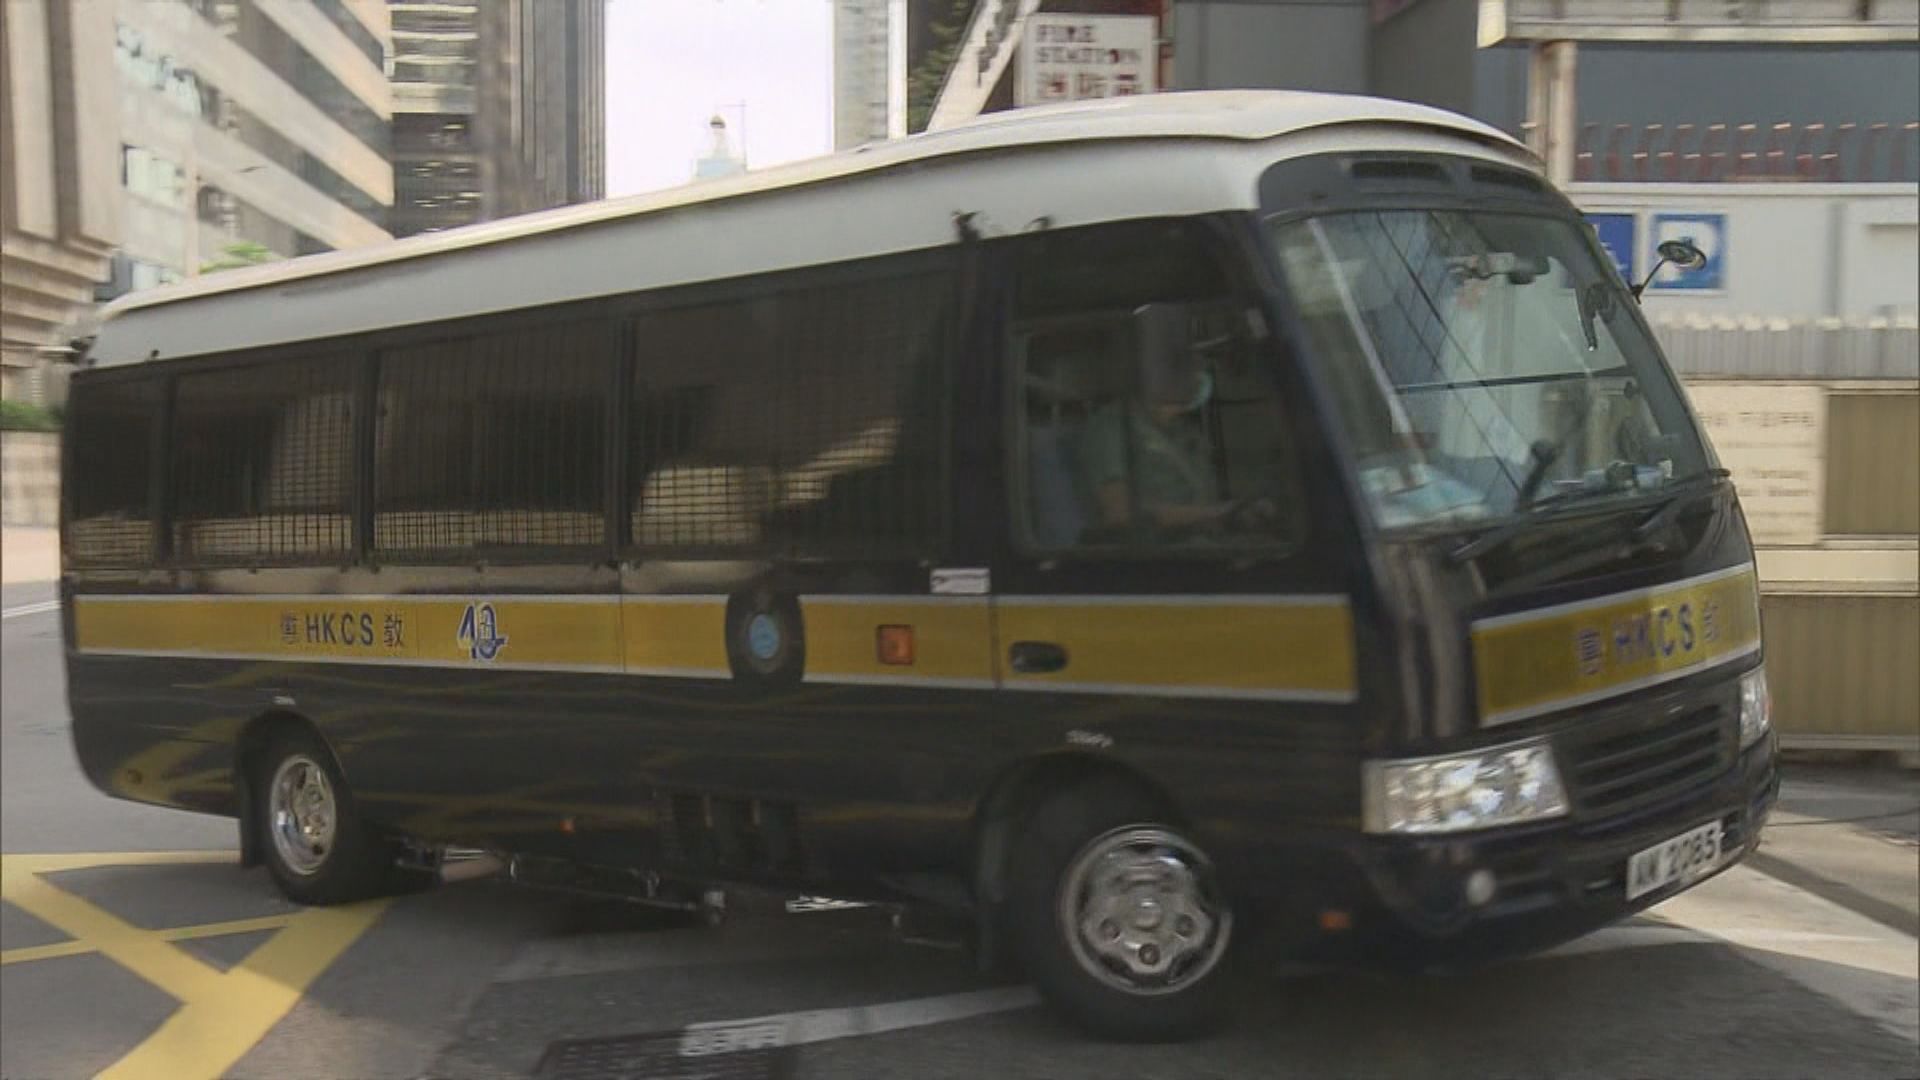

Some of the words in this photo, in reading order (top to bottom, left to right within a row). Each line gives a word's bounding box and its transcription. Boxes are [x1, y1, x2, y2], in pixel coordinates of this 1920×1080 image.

[1037, 24, 1096, 43] FIRE
[1036, 47, 1142, 64] STATION
[305, 611, 374, 646] HKCS
[1613, 601, 1696, 664] HKCS
